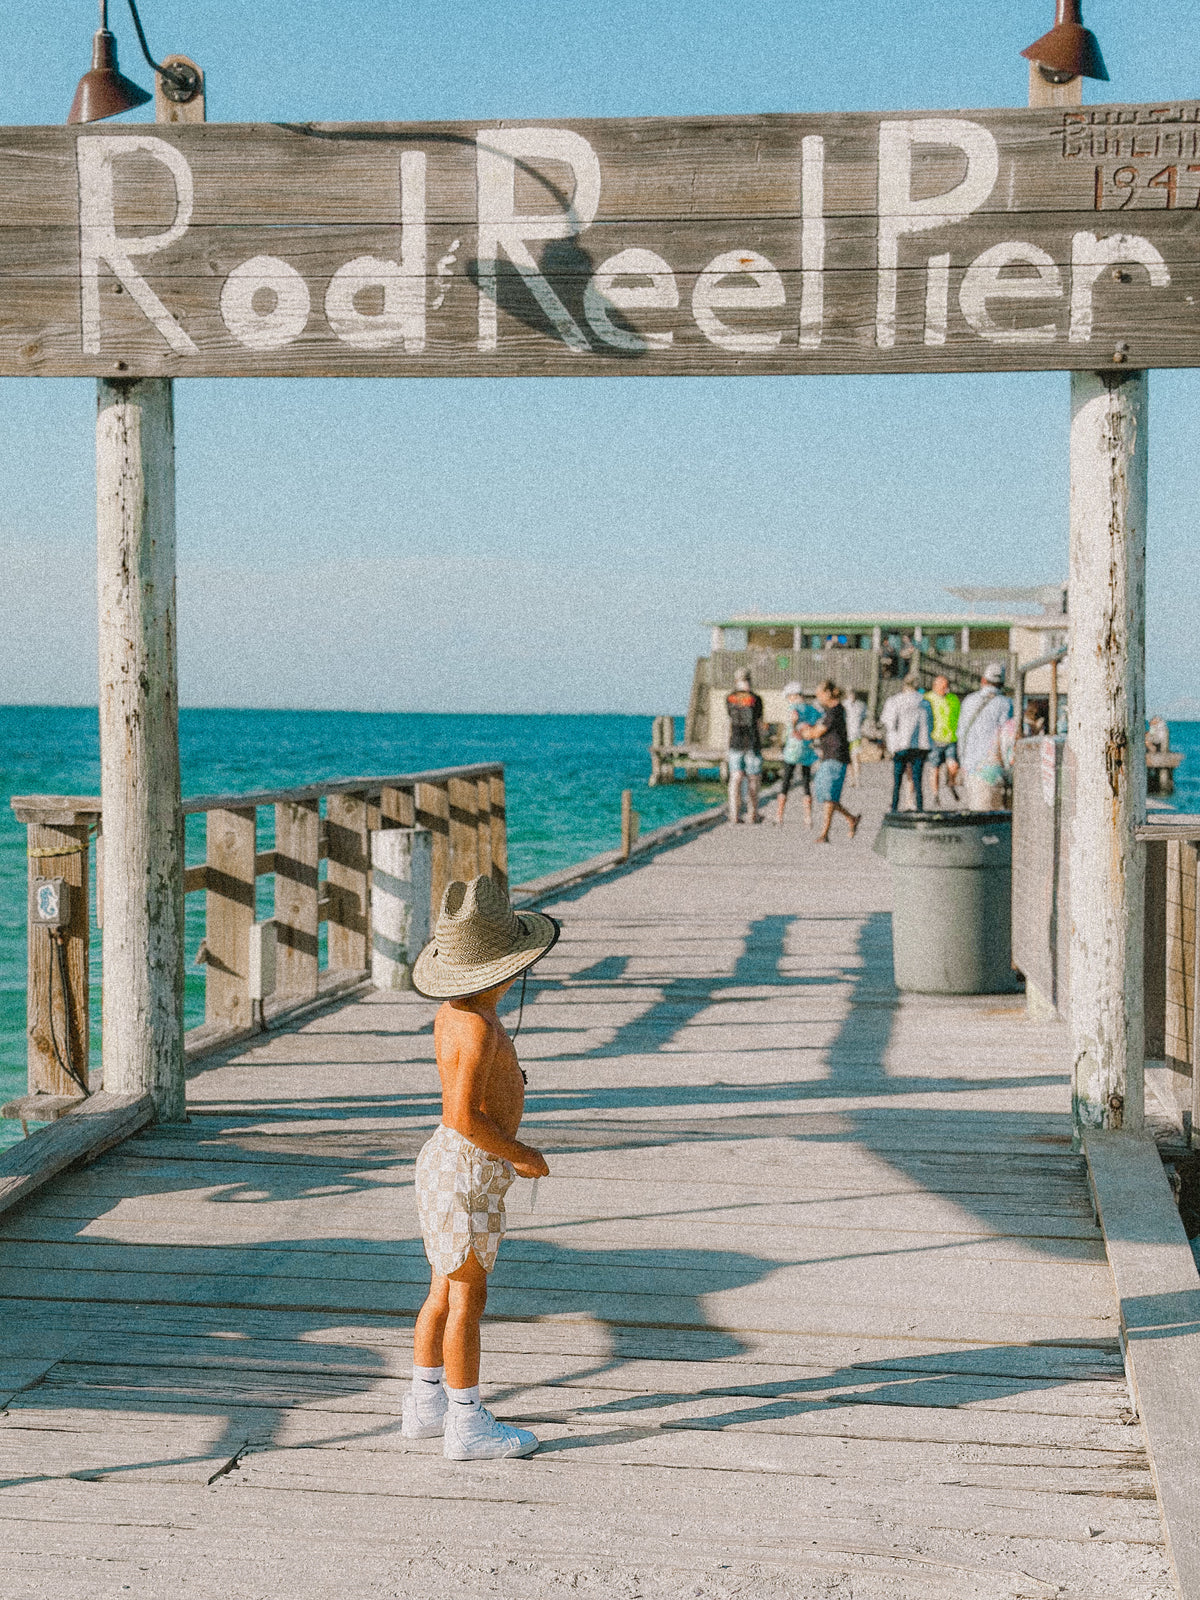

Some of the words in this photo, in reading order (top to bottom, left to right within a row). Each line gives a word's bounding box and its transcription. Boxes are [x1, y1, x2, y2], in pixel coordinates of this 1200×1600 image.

[77, 134, 427, 355] Rod
[476, 127, 825, 353] Reel
[876, 118, 1171, 350] Pier
[1094, 165, 1200, 212] 1947
